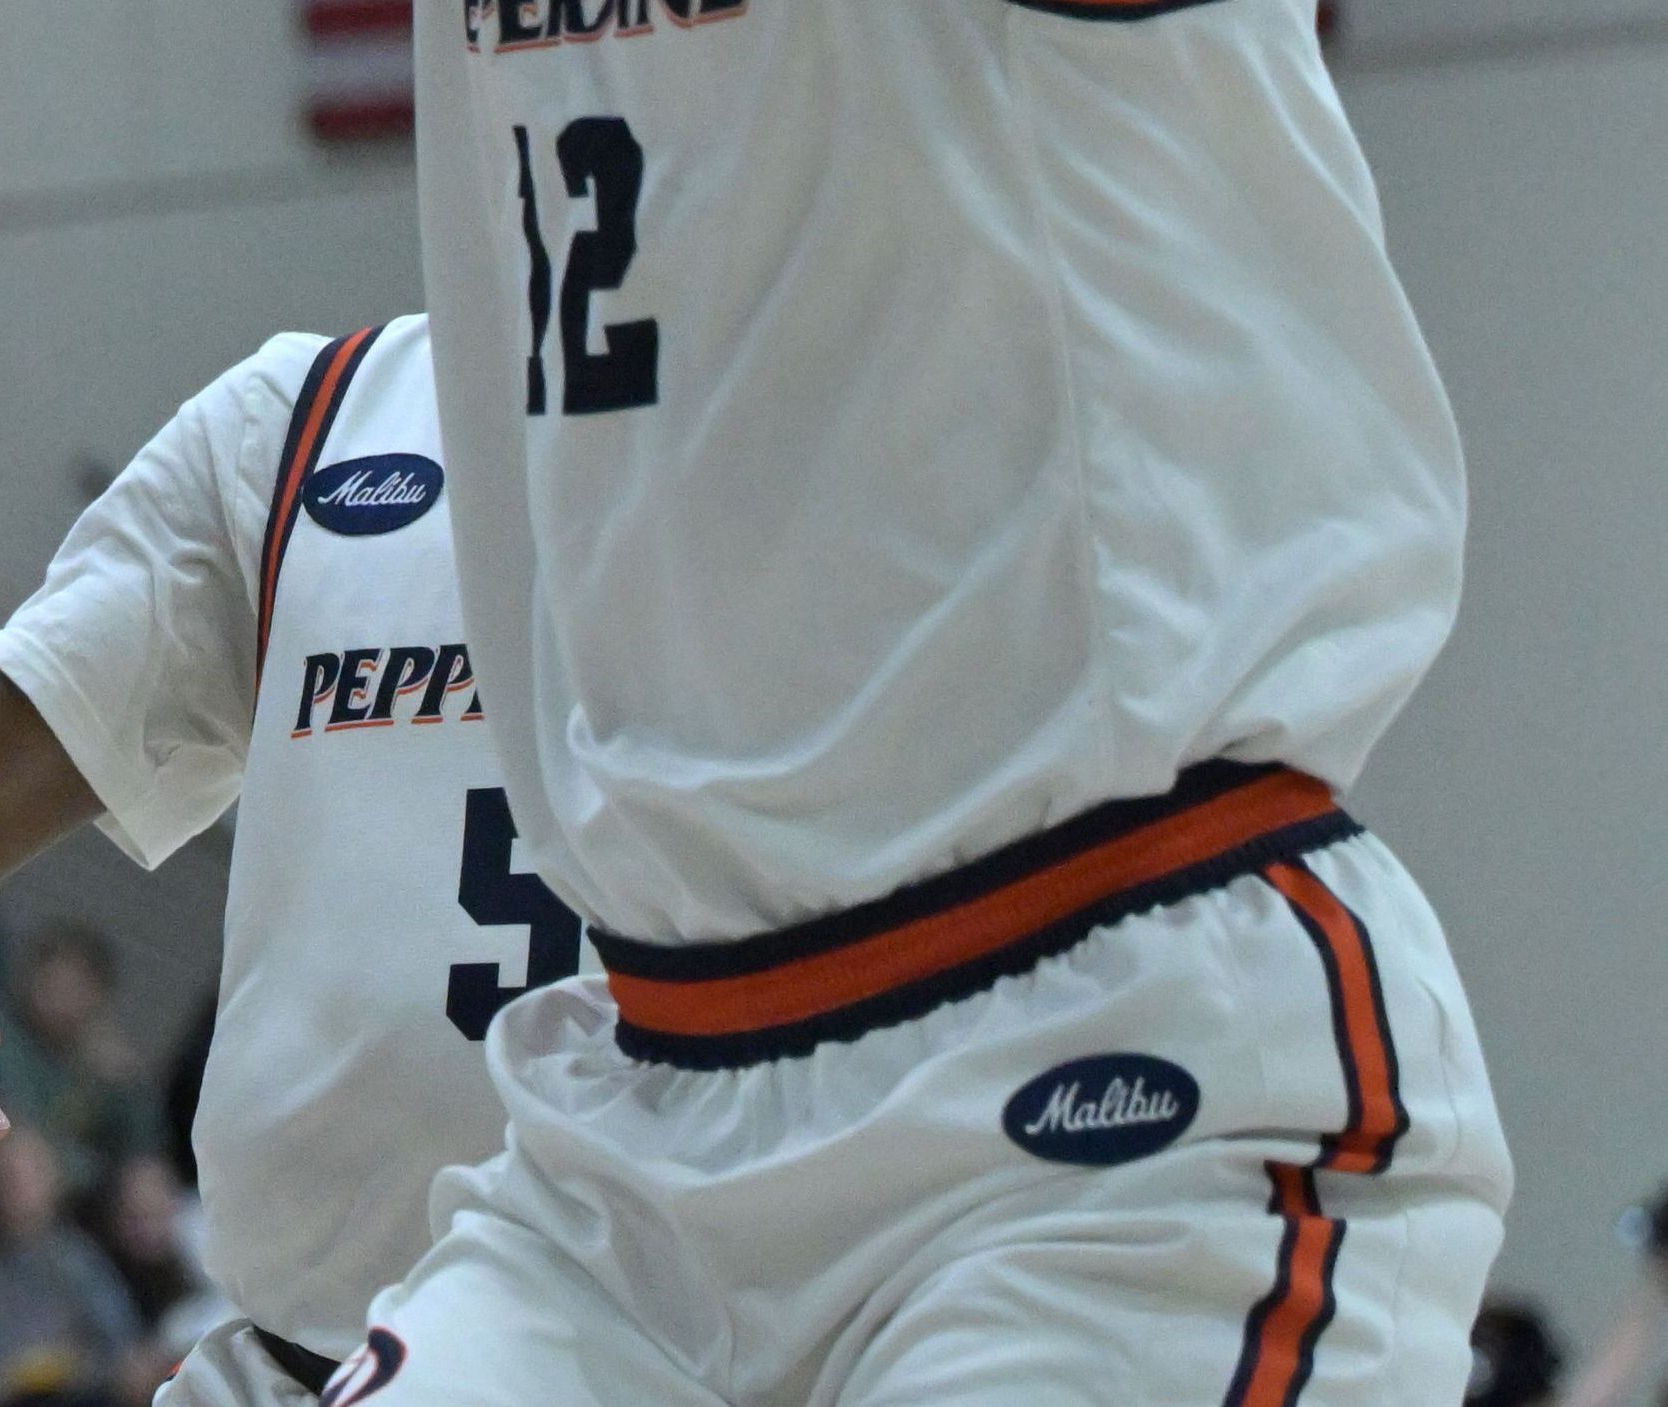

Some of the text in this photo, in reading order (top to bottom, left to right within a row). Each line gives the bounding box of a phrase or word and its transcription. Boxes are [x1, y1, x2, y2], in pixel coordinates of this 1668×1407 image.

[512, 116, 659, 416] 12
[317, 470, 427, 507] Malibu
[291, 643, 485, 738] PEPP
[446, 787, 581, 1040] 5
[1025, 1076, 1180, 1136] Malibu
